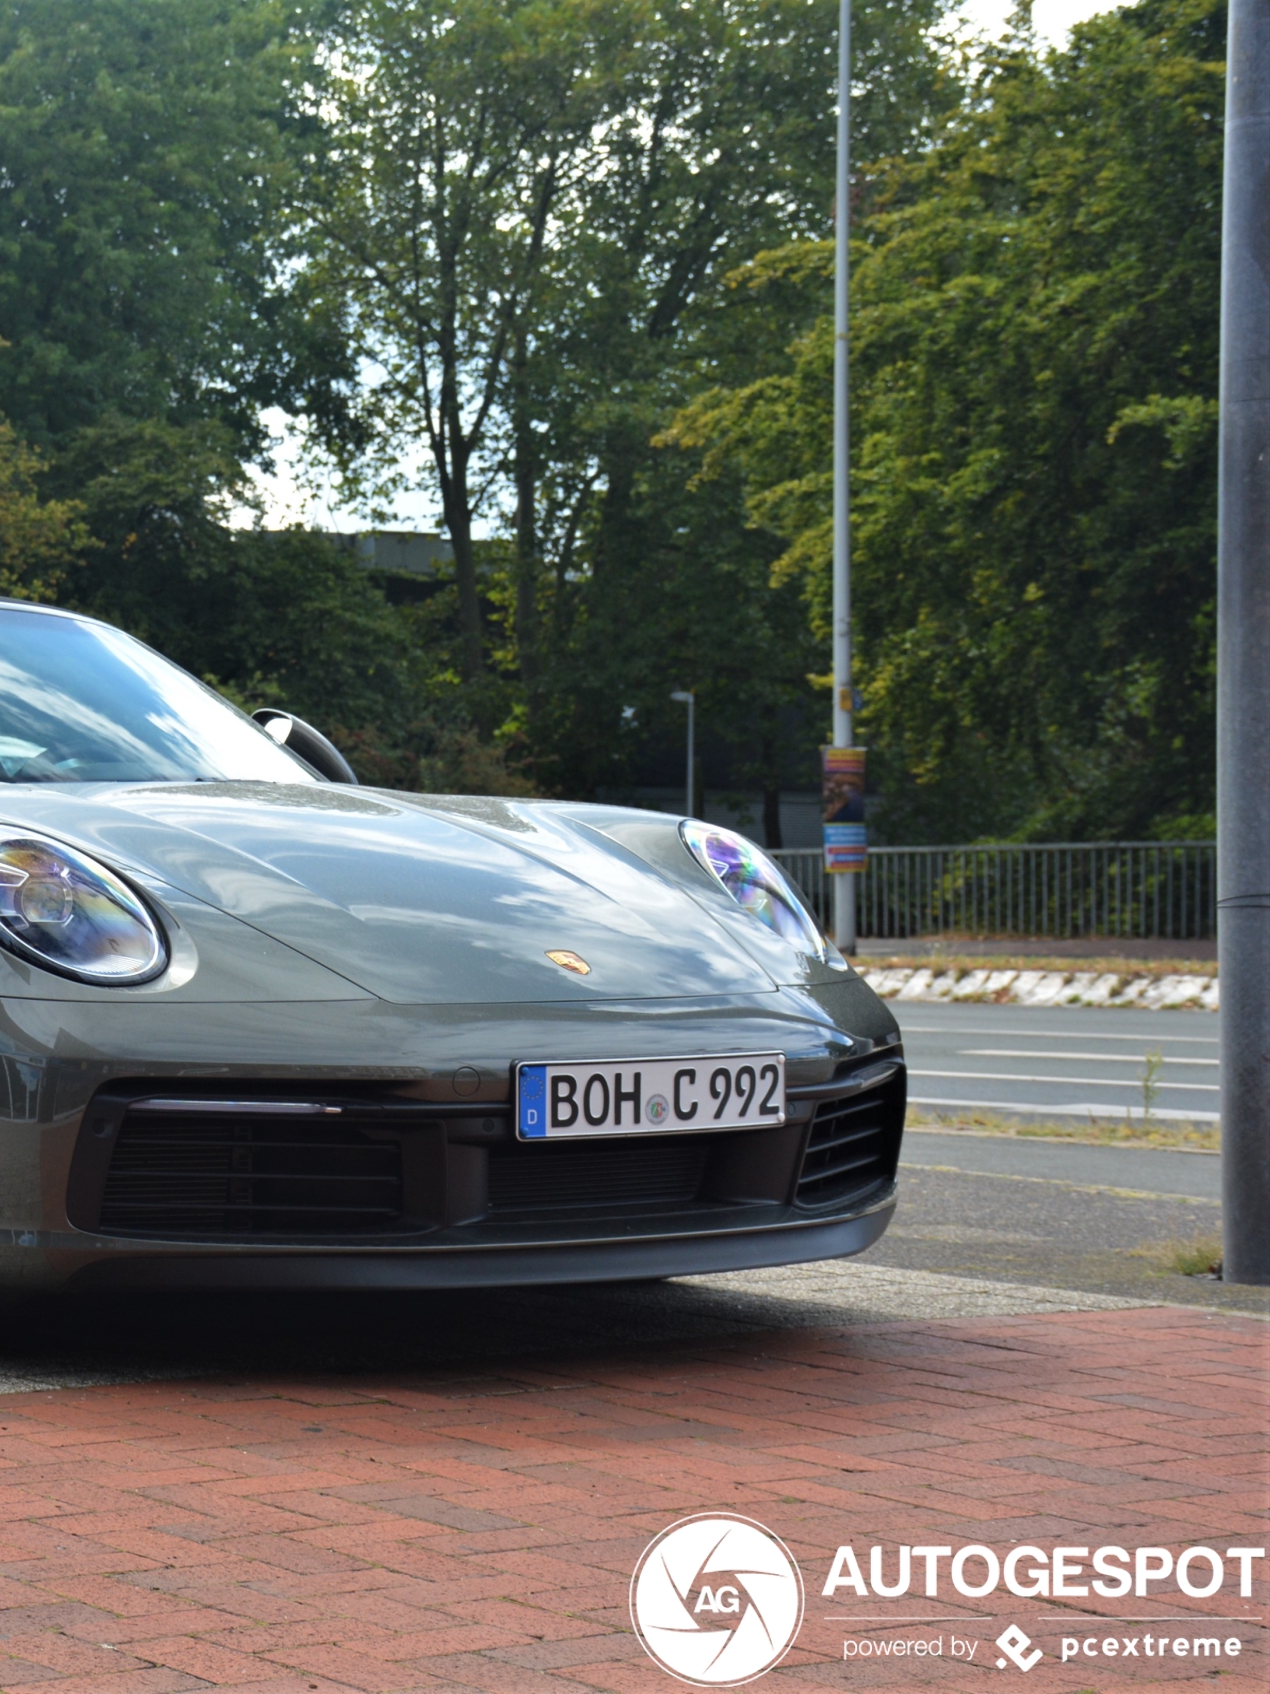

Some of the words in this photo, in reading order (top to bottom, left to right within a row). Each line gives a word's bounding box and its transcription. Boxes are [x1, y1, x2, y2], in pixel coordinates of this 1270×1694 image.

[551, 1071, 641, 1128] BOH
[674, 1068, 698, 1121] C
[709, 1063, 780, 1119] 992
[527, 1109, 538, 1125] D
